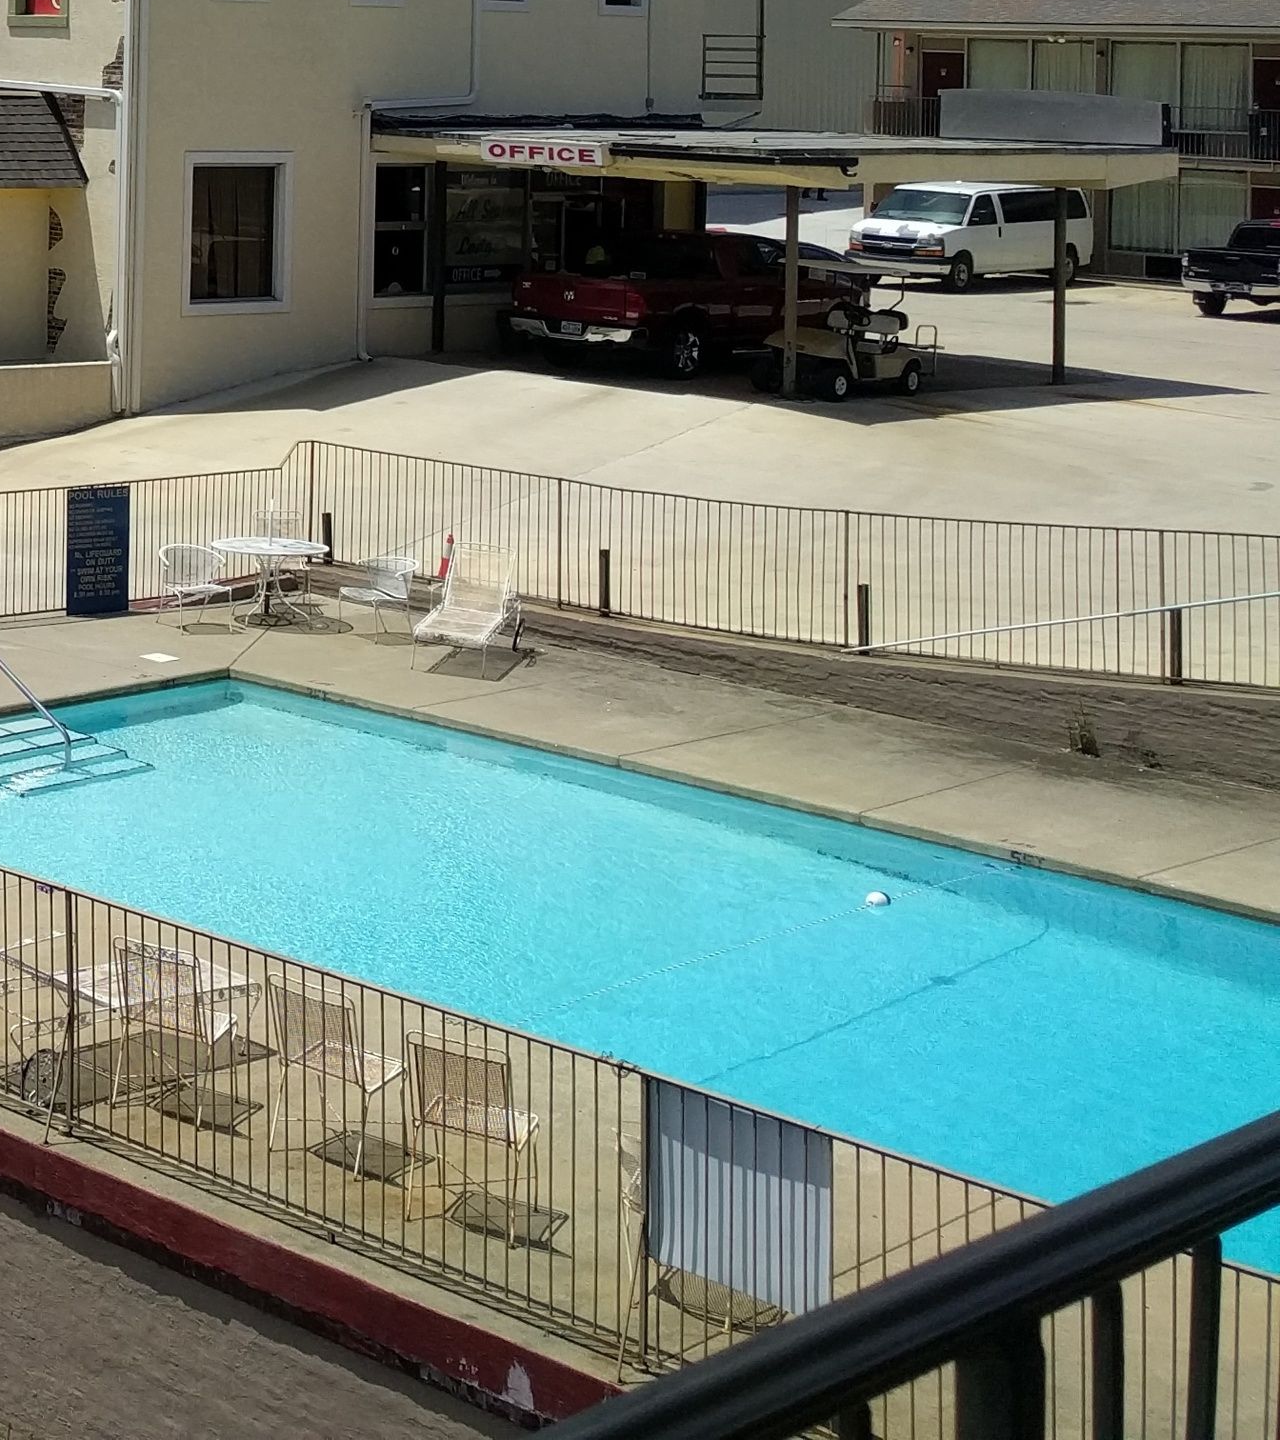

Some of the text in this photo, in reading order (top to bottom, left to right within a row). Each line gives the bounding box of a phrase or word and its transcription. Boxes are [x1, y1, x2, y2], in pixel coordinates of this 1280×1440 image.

[488, 143, 595, 163] OFFICE
[452, 267, 482, 281] OFFICE
[69, 488, 128, 500] POOL RULES
